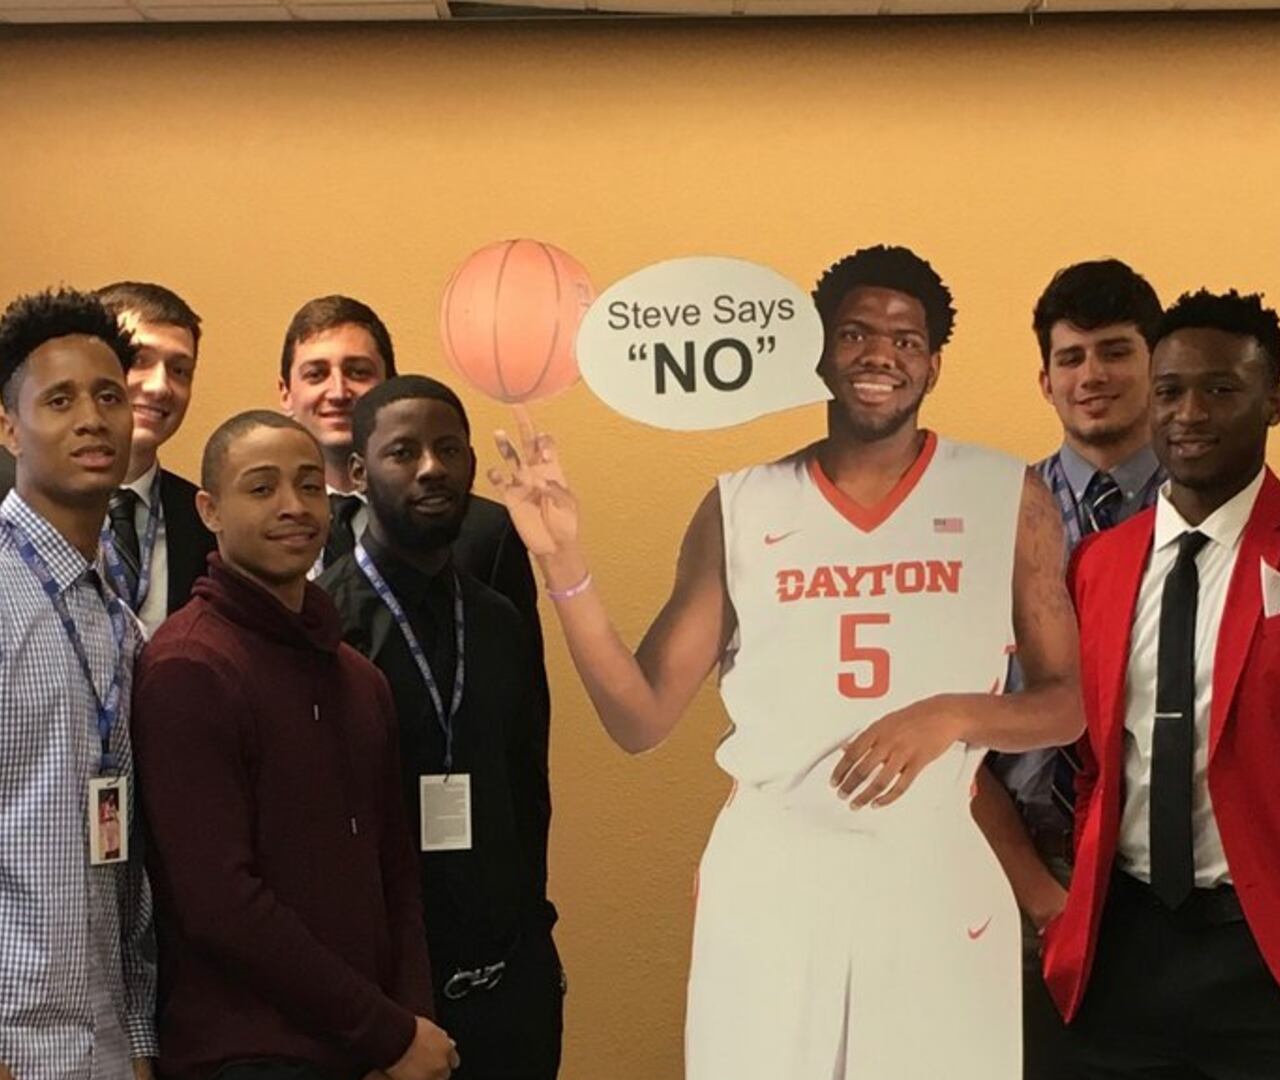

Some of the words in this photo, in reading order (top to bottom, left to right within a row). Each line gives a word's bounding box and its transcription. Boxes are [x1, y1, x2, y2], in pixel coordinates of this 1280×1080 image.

[608, 301, 701, 330] Steve
[713, 294, 795, 329] Says
[775, 560, 963, 603] DAYTON
[837, 612, 891, 699] 5
